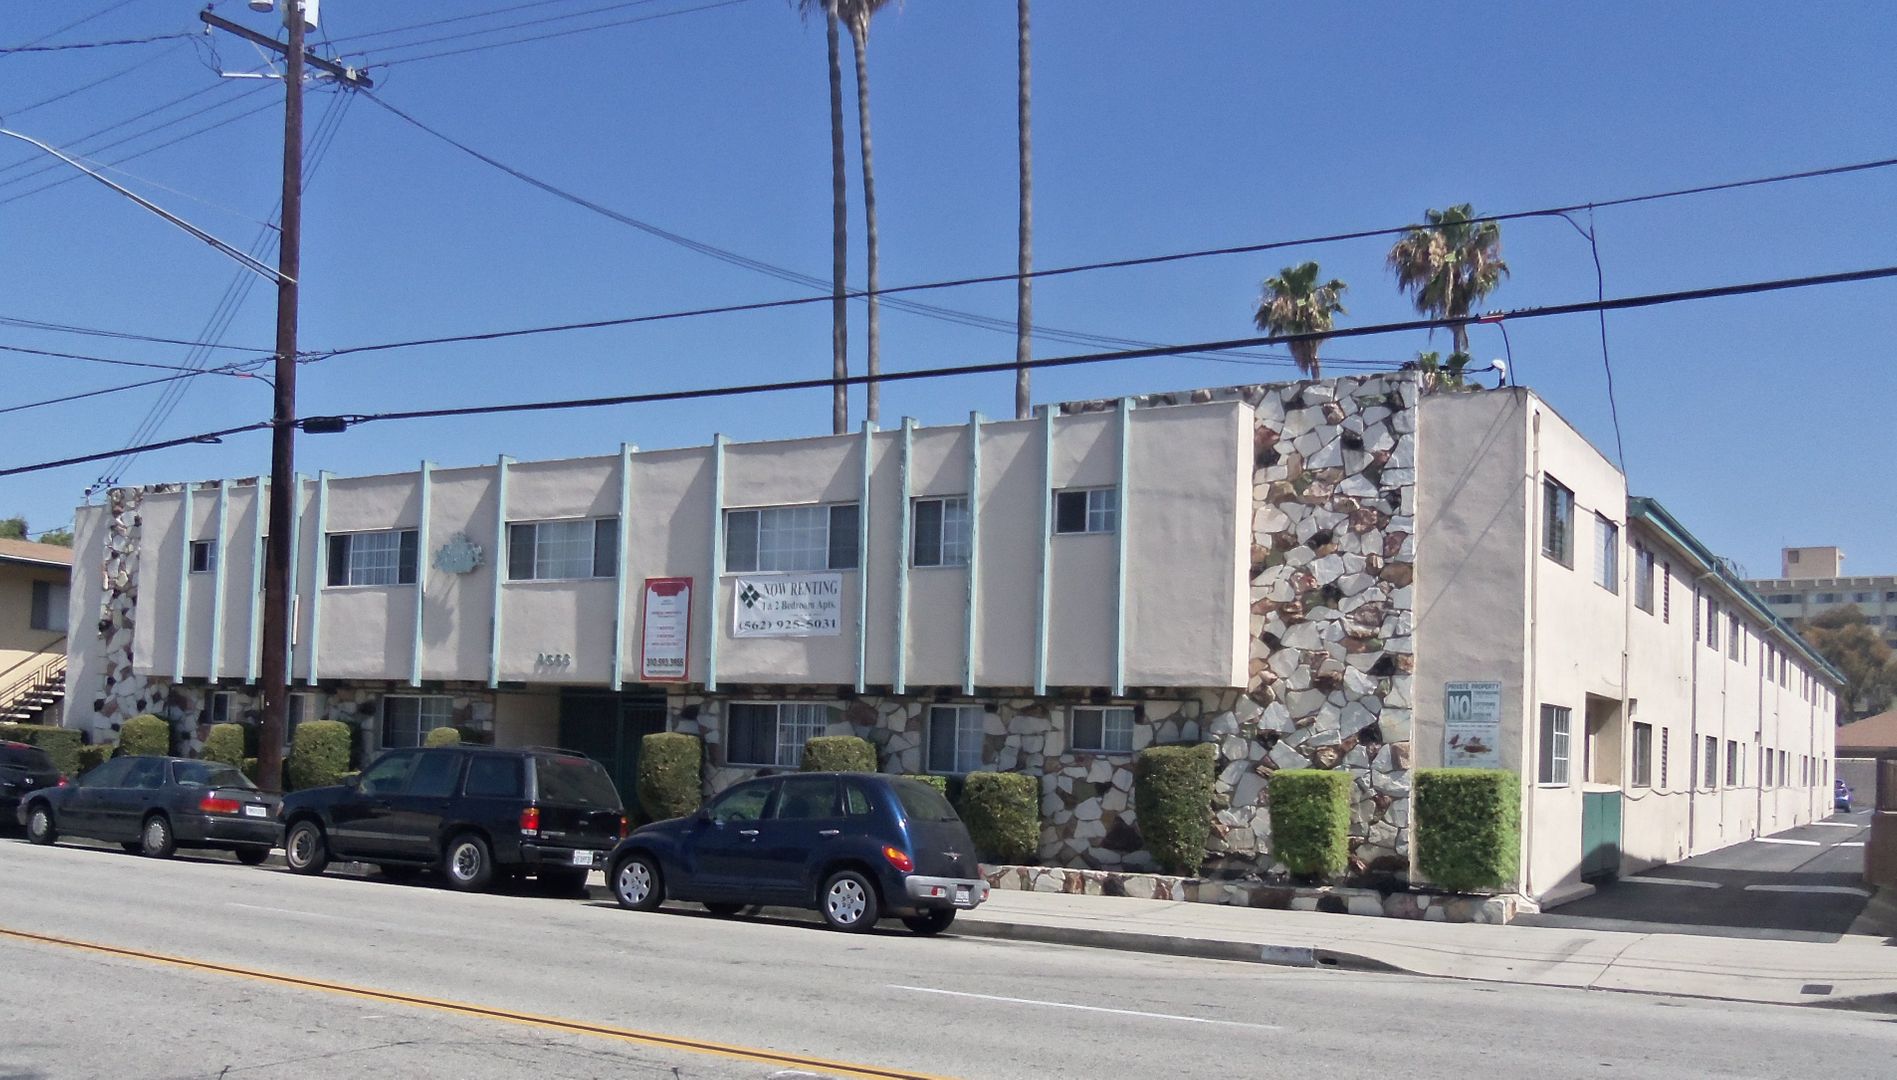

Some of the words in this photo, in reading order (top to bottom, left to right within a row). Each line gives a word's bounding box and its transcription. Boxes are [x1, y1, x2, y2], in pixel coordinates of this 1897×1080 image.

[764, 583, 786, 597] NOW
[791, 581, 837, 596] RENTING
[781, 601, 815, 610] Bedroom
[739, 621, 772, 631] (562)
[776, 619, 836, 630] 925-5031
[1450, 695, 1470, 720] NO
